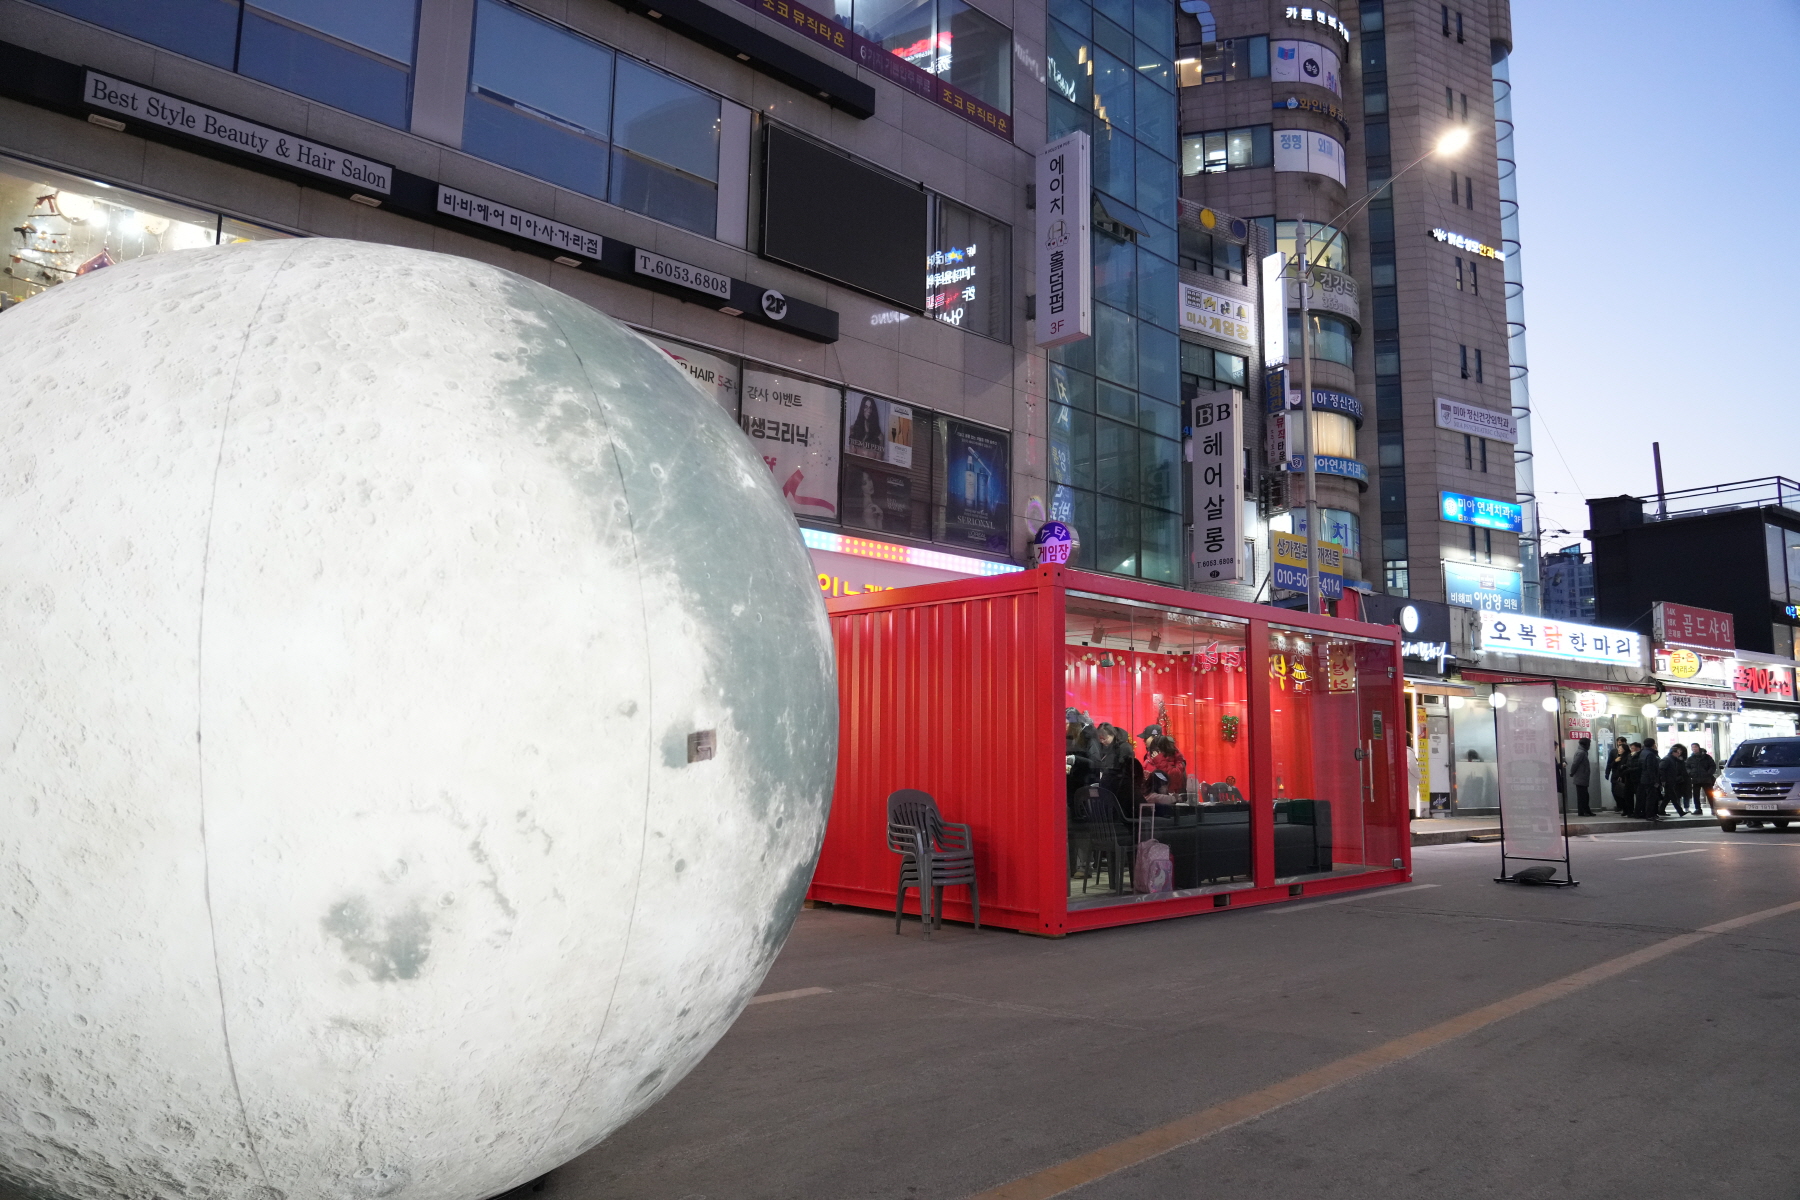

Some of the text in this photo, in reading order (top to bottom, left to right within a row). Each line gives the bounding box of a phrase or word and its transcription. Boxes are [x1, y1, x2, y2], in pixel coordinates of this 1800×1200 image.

[793, 9, 845, 48] 뮤직타운
[943, 88, 1007, 133] 조코 뮤직타운
[92, 79, 387, 190] Best Style Beauty & Hair Salon
[640, 256, 728, 295] T.6053.6808
[1049, 250, 1064, 315] 홀덤펍
[764, 293, 787, 315] 2F
[1050, 319, 1065, 335] 3F
[1209, 316, 1249, 340] 게임장
[690, 365, 715, 384] HAIR
[747, 385, 803, 408] 감사 이벤트
[1467, 409, 1509, 428] 정신건강의학과
[1275, 417, 1285, 461] 뮤직타운
[1203, 431, 1225, 554] 헤어살롱
[1457, 498, 1475, 513] 미아
[1477, 502, 1510, 519] 연세치과
[1513, 515, 1522, 524] 3F
[1040, 525, 1066, 542] 스타
[1037, 544, 1069, 562] 게임장
[1277, 568, 1340, 594] 010-50-4114
[1682, 613, 1731, 643] 골드샤인
[1672, 665, 1696, 673] 거래소
